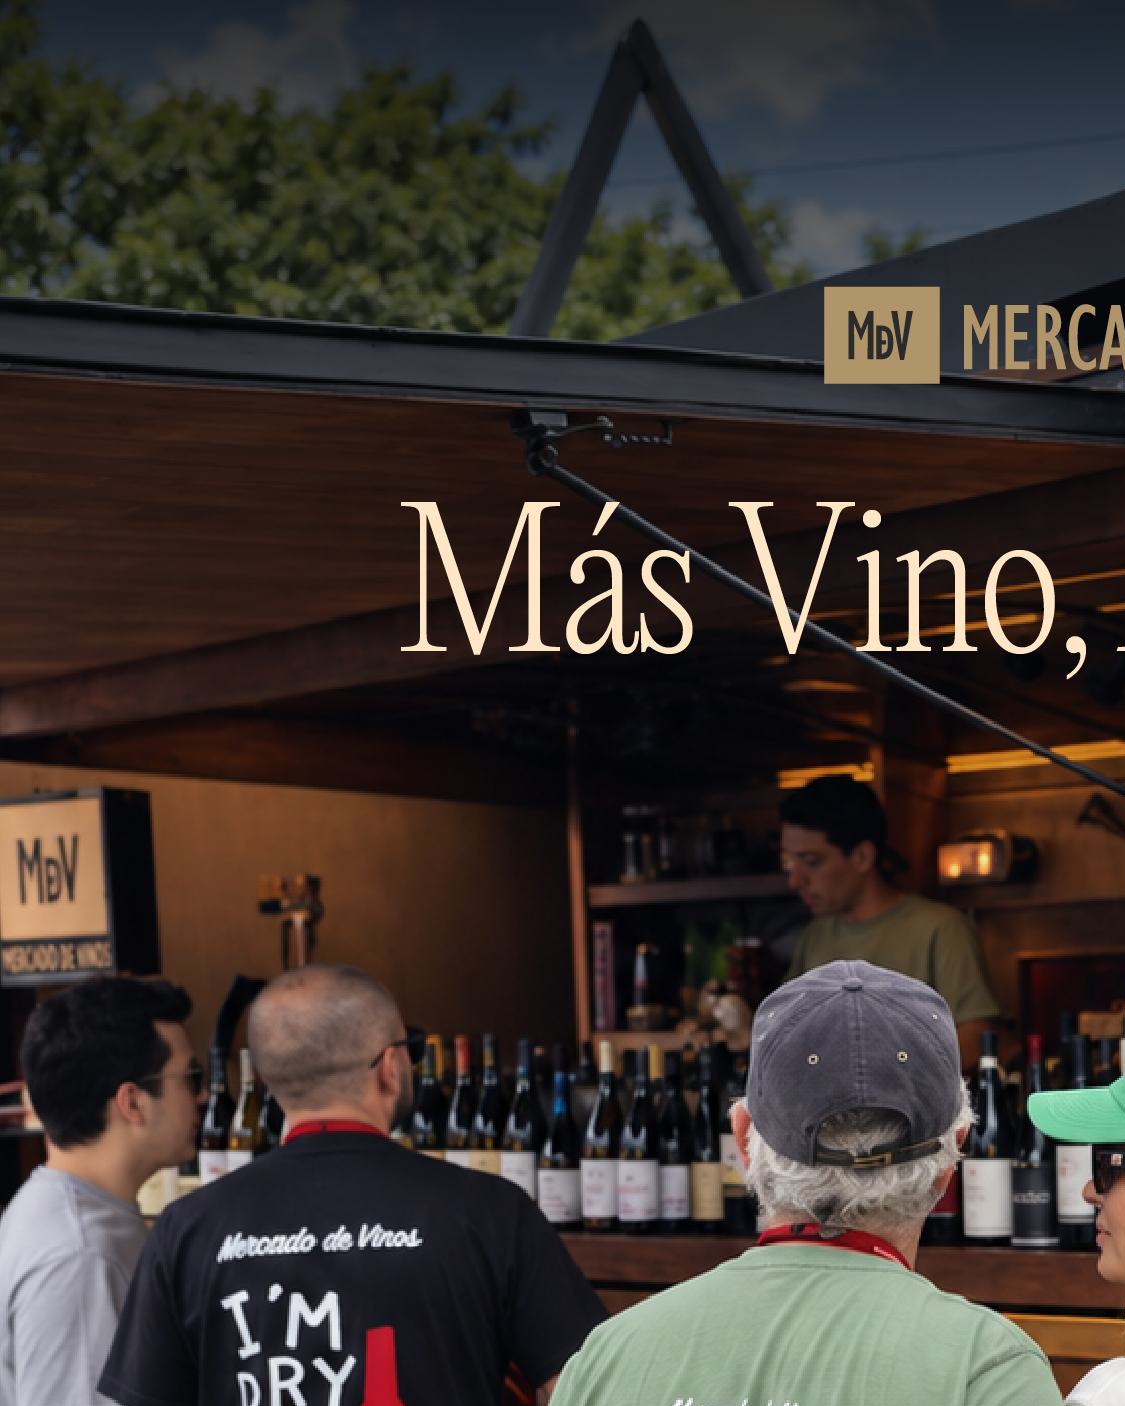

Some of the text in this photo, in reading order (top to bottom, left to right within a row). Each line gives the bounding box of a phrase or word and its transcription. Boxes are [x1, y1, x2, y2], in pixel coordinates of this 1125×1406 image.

[216, 1222, 424, 1264] Mercado de Vinos
[220, 1282, 343, 1360] I'M
